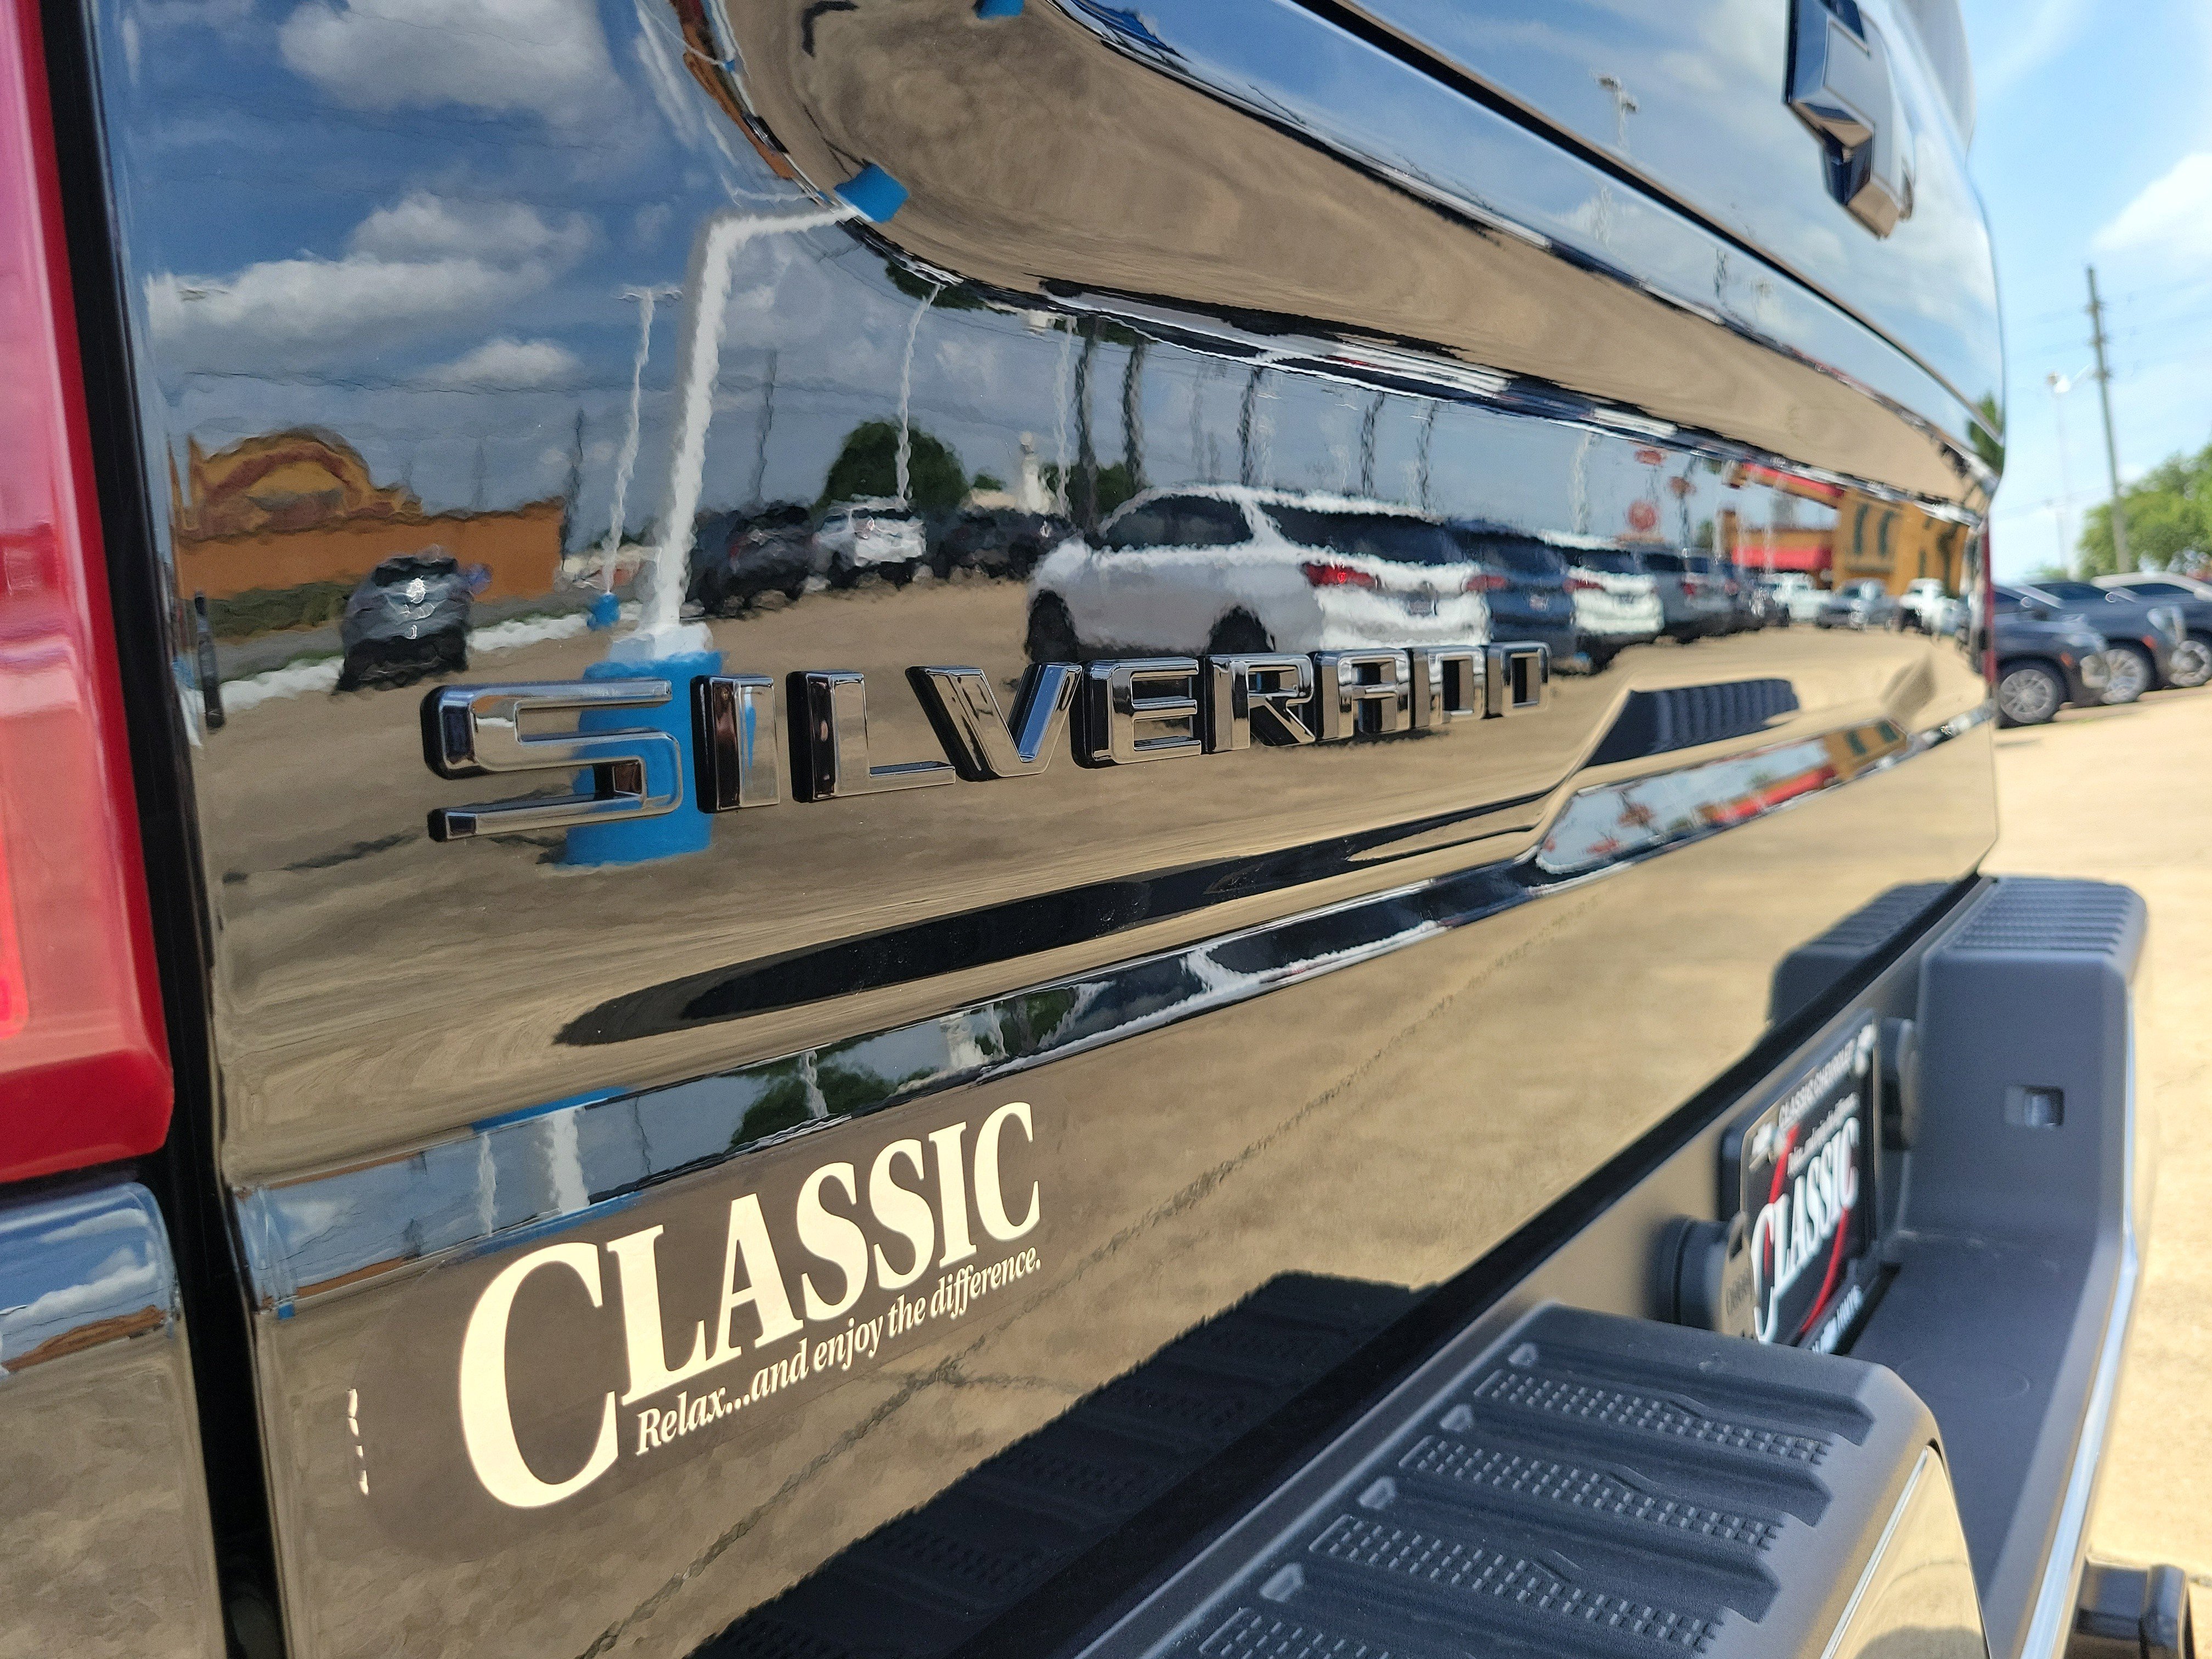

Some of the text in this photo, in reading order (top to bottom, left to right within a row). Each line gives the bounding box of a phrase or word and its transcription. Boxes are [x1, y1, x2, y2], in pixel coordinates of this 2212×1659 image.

[420, 641, 1551, 841] SILVERADO
[459, 1102, 1041, 1508] CLASSIC
[814, 1317, 884, 1371] enjoy
[888, 1294, 926, 1338] the
[930, 1246, 1041, 1320] difference.
[1751, 1117, 1860, 1344] CLASSIC
